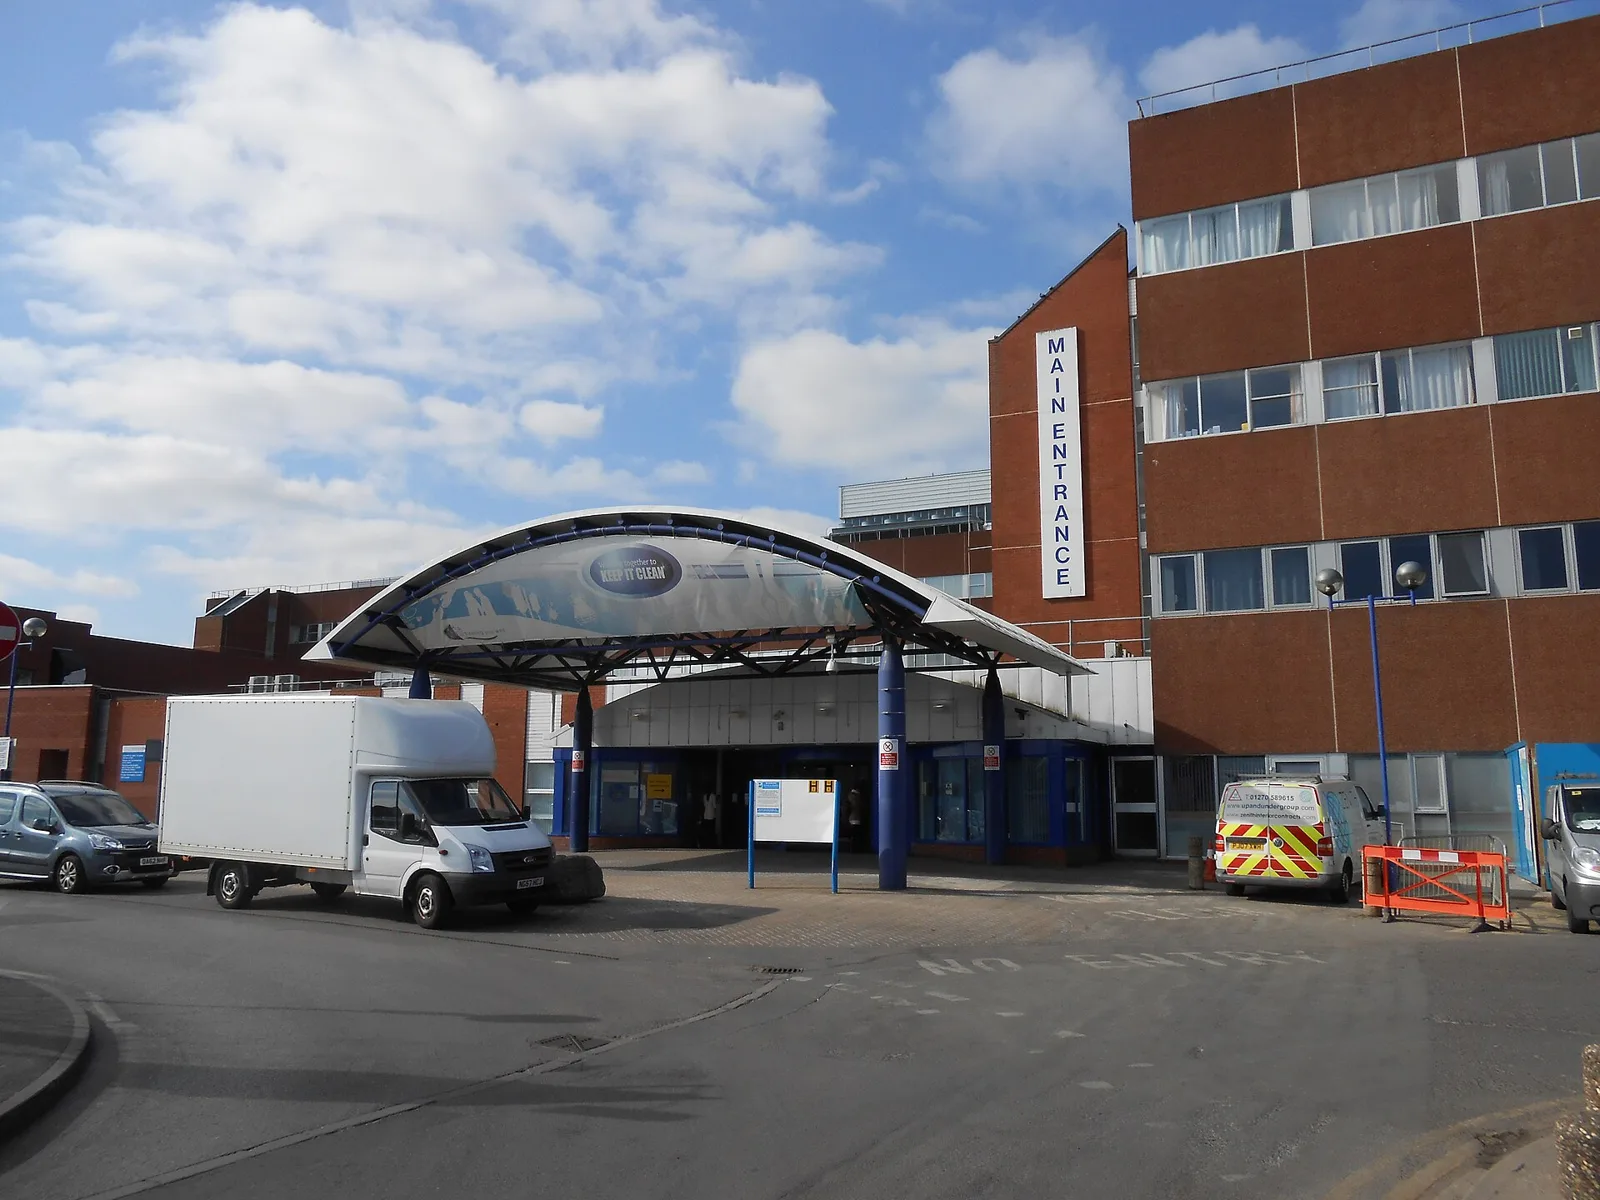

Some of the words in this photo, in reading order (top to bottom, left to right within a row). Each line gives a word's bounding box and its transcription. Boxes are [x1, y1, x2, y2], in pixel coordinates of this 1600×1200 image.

[1048, 337, 1066, 414] MAIN
[1052, 423, 1070, 585] ENTRANCE
[601, 569, 623, 582] KEEP
[624, 567, 635, 581] IT
[636, 566, 666, 580] CLEAN
[650, 558, 657, 566] to
[916, 957, 1023, 976] NO
[1064, 950, 1329, 970] ENTRY
